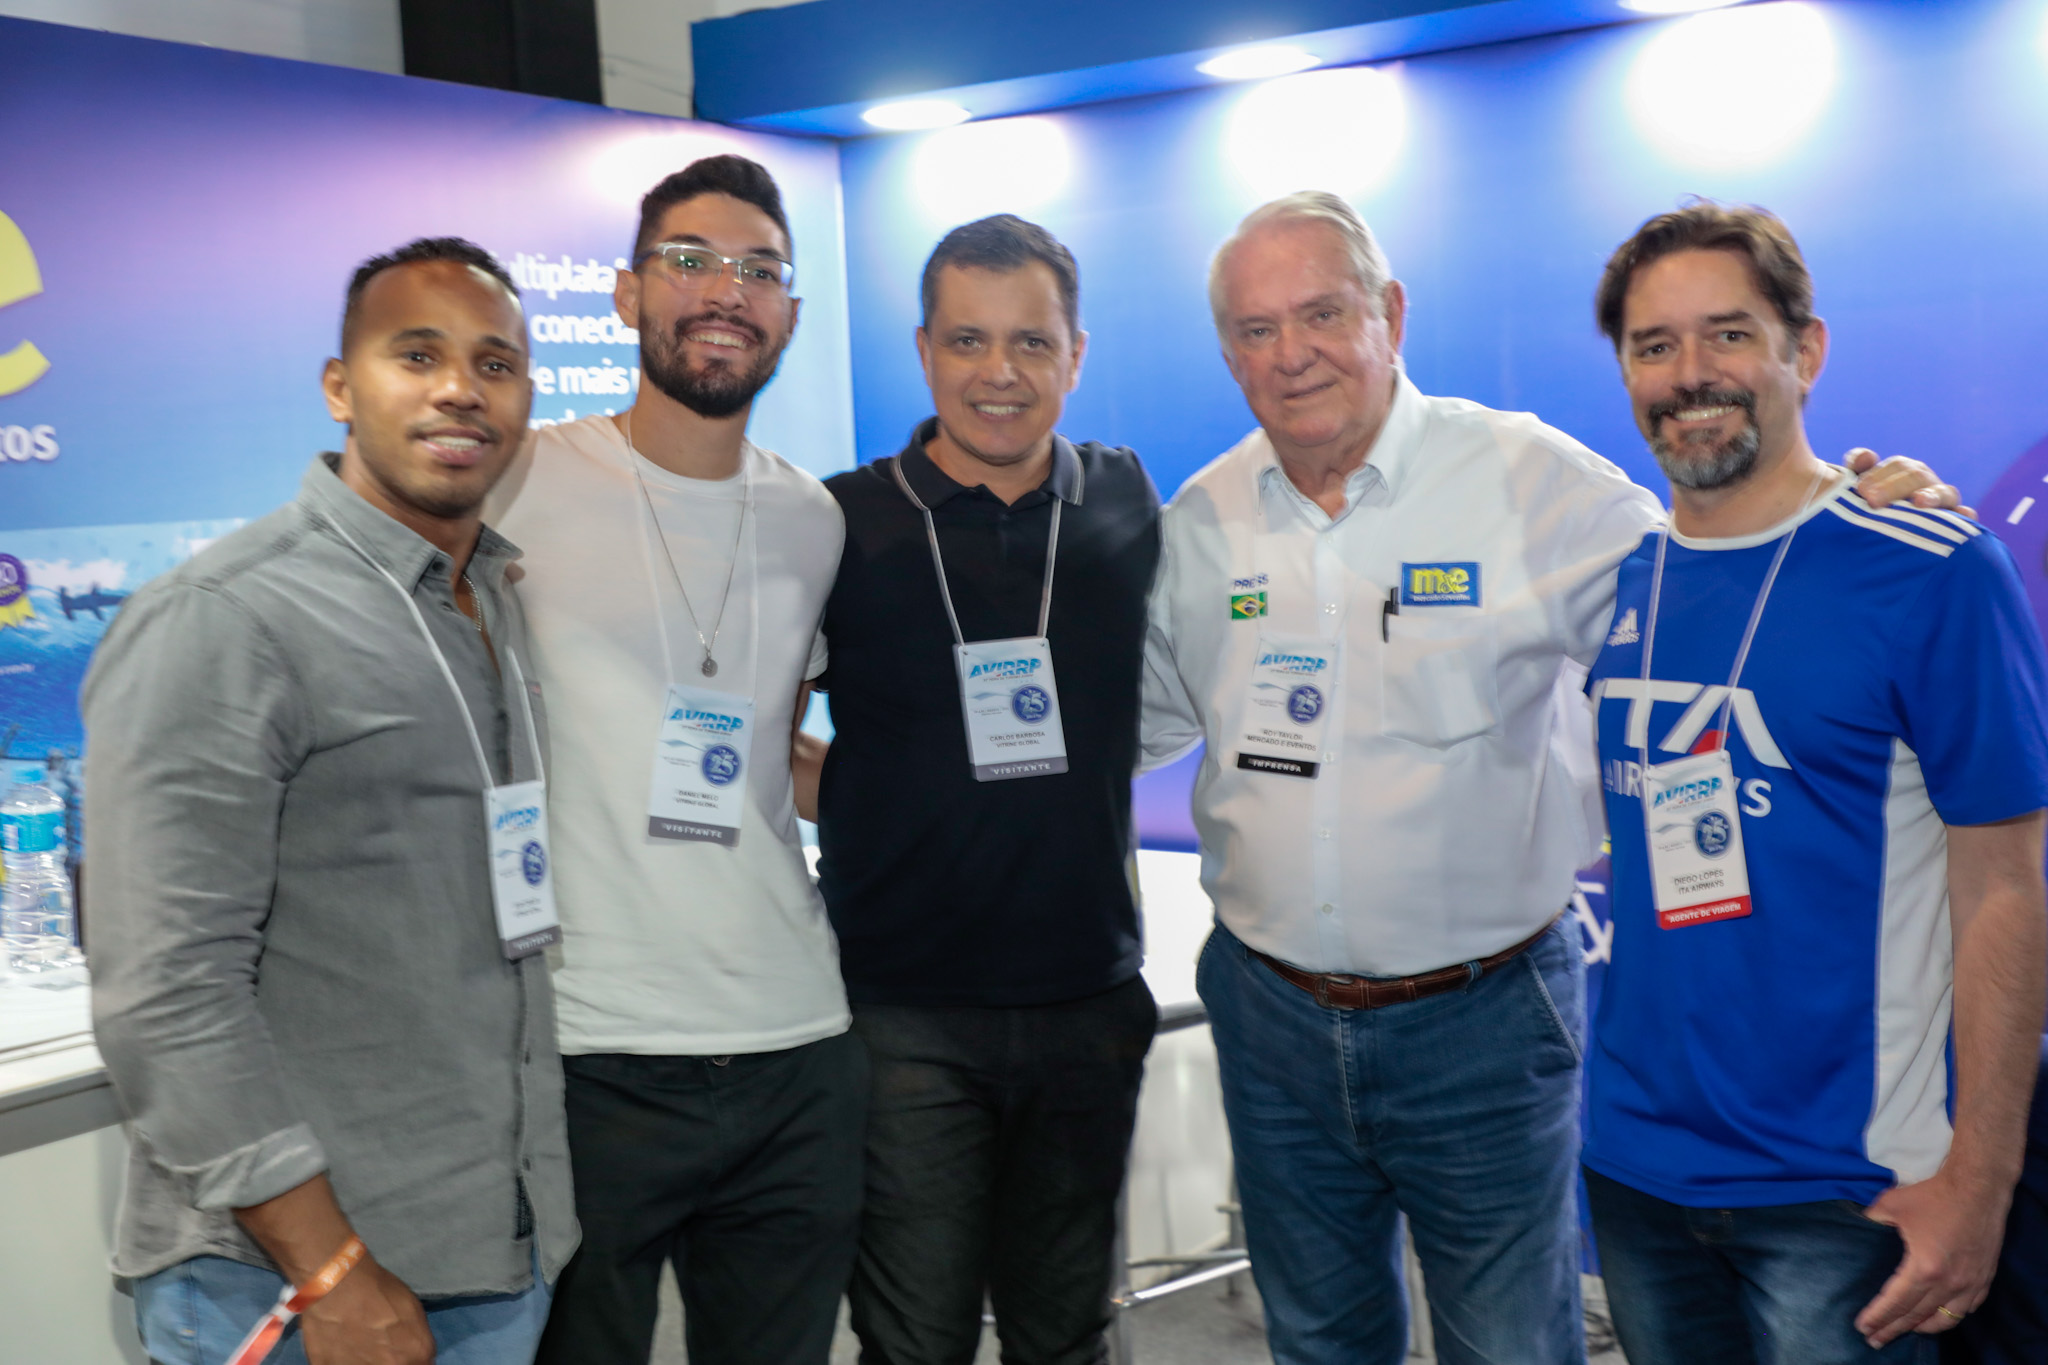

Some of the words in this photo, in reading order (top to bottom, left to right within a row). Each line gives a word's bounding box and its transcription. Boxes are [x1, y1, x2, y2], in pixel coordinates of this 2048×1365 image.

[558, 358, 631, 395] mais
[968, 658, 1041, 679] AVIRRP
[669, 708, 744, 733] AVIRRP
[989, 734, 1015, 742] CARLOS
[1015, 731, 1045, 739] BARBOSA
[1247, 735, 1279, 746] MERCADO
[1286, 741, 1316, 751] EVENTOS
[1278, 731, 1303, 741] TAYLOR
[992, 763, 1051, 775] VISITANTE
[1252, 759, 1302, 773] IMPRENSA
[1653, 777, 1723, 809] AVIRRP
[664, 823, 723, 839] VISITANTE
[1673, 875, 1698, 886] DIEGO
[1699, 869, 1725, 881] LOPES
[1678, 887, 1690, 895] ITA
[1691, 879, 1725, 893] AIRWAYS
[1668, 911, 1699, 923] AGENTE
[1700, 909, 1711, 917] DE
[1711, 903, 1742, 915] VIAGEM
